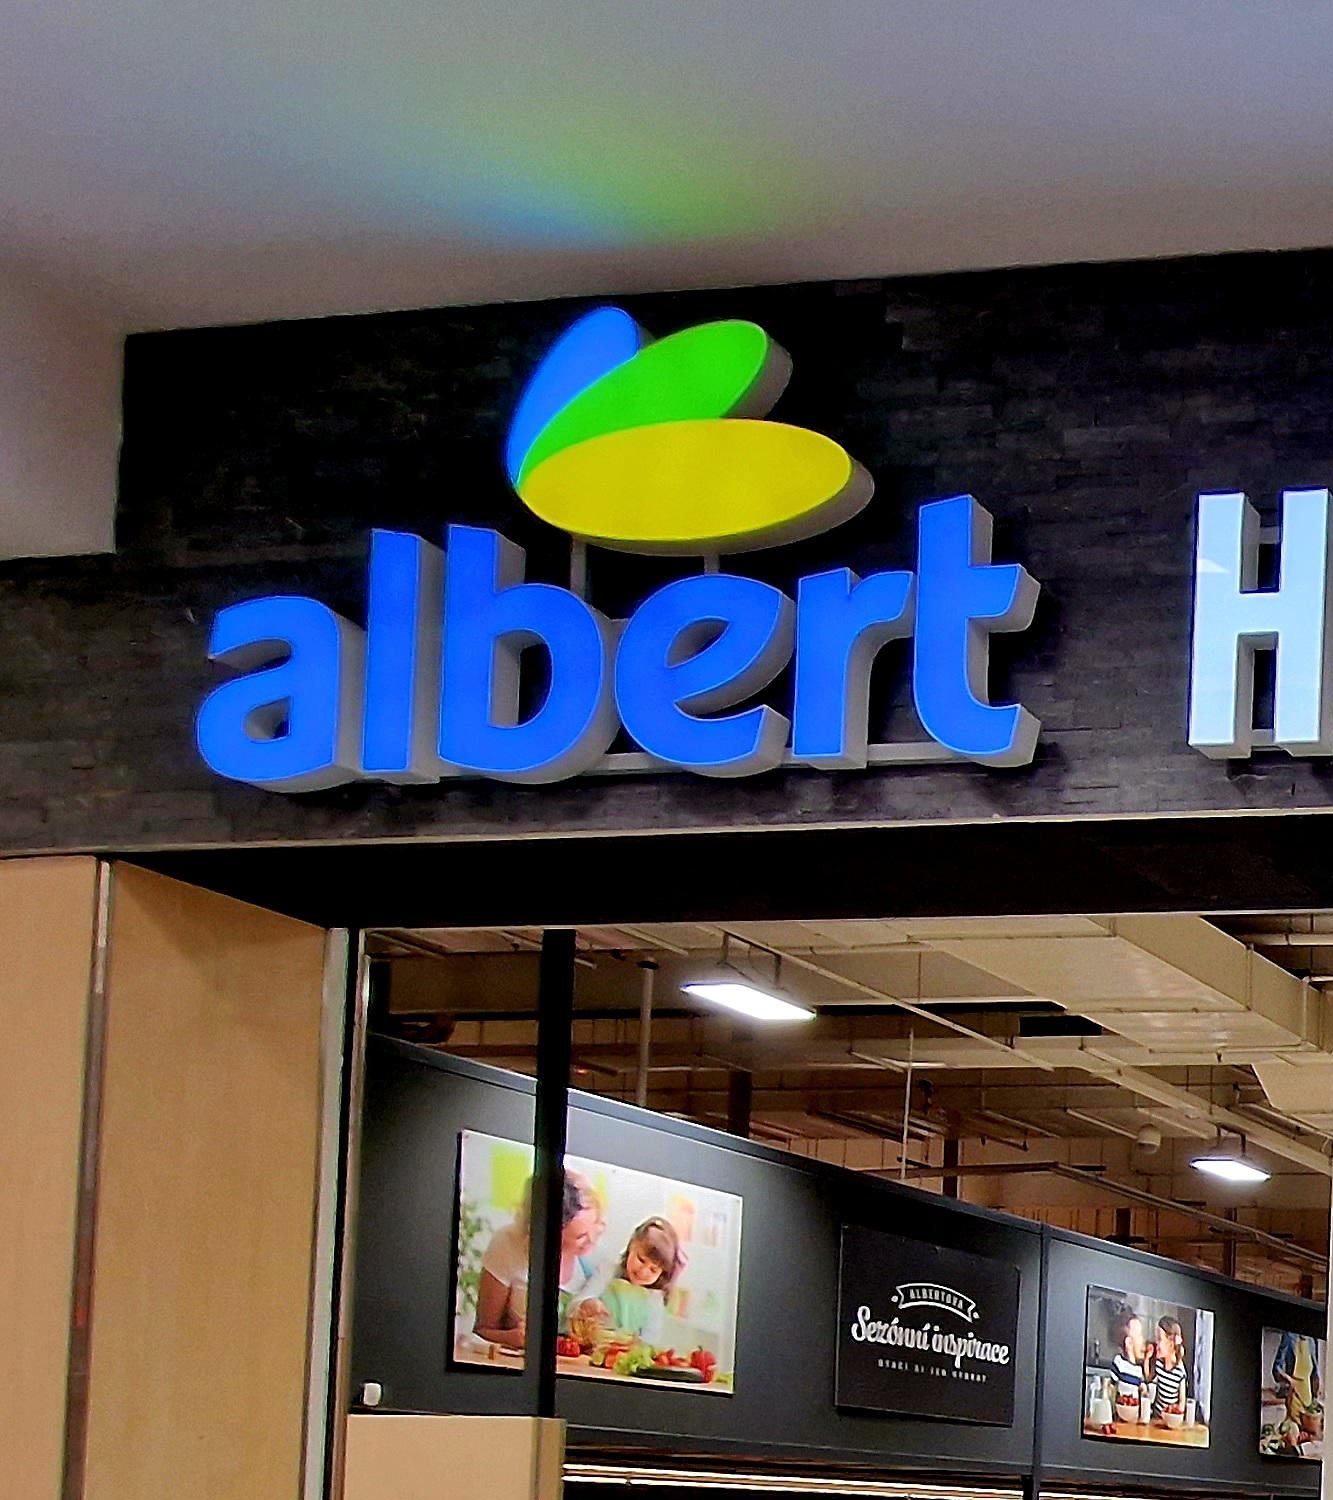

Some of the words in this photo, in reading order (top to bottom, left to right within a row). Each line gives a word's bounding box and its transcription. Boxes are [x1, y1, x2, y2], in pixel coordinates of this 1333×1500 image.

[195, 494, 1037, 789] albert
[851, 1306, 930, 1351] Sezónní
[932, 1325, 1010, 1369] inspirace
